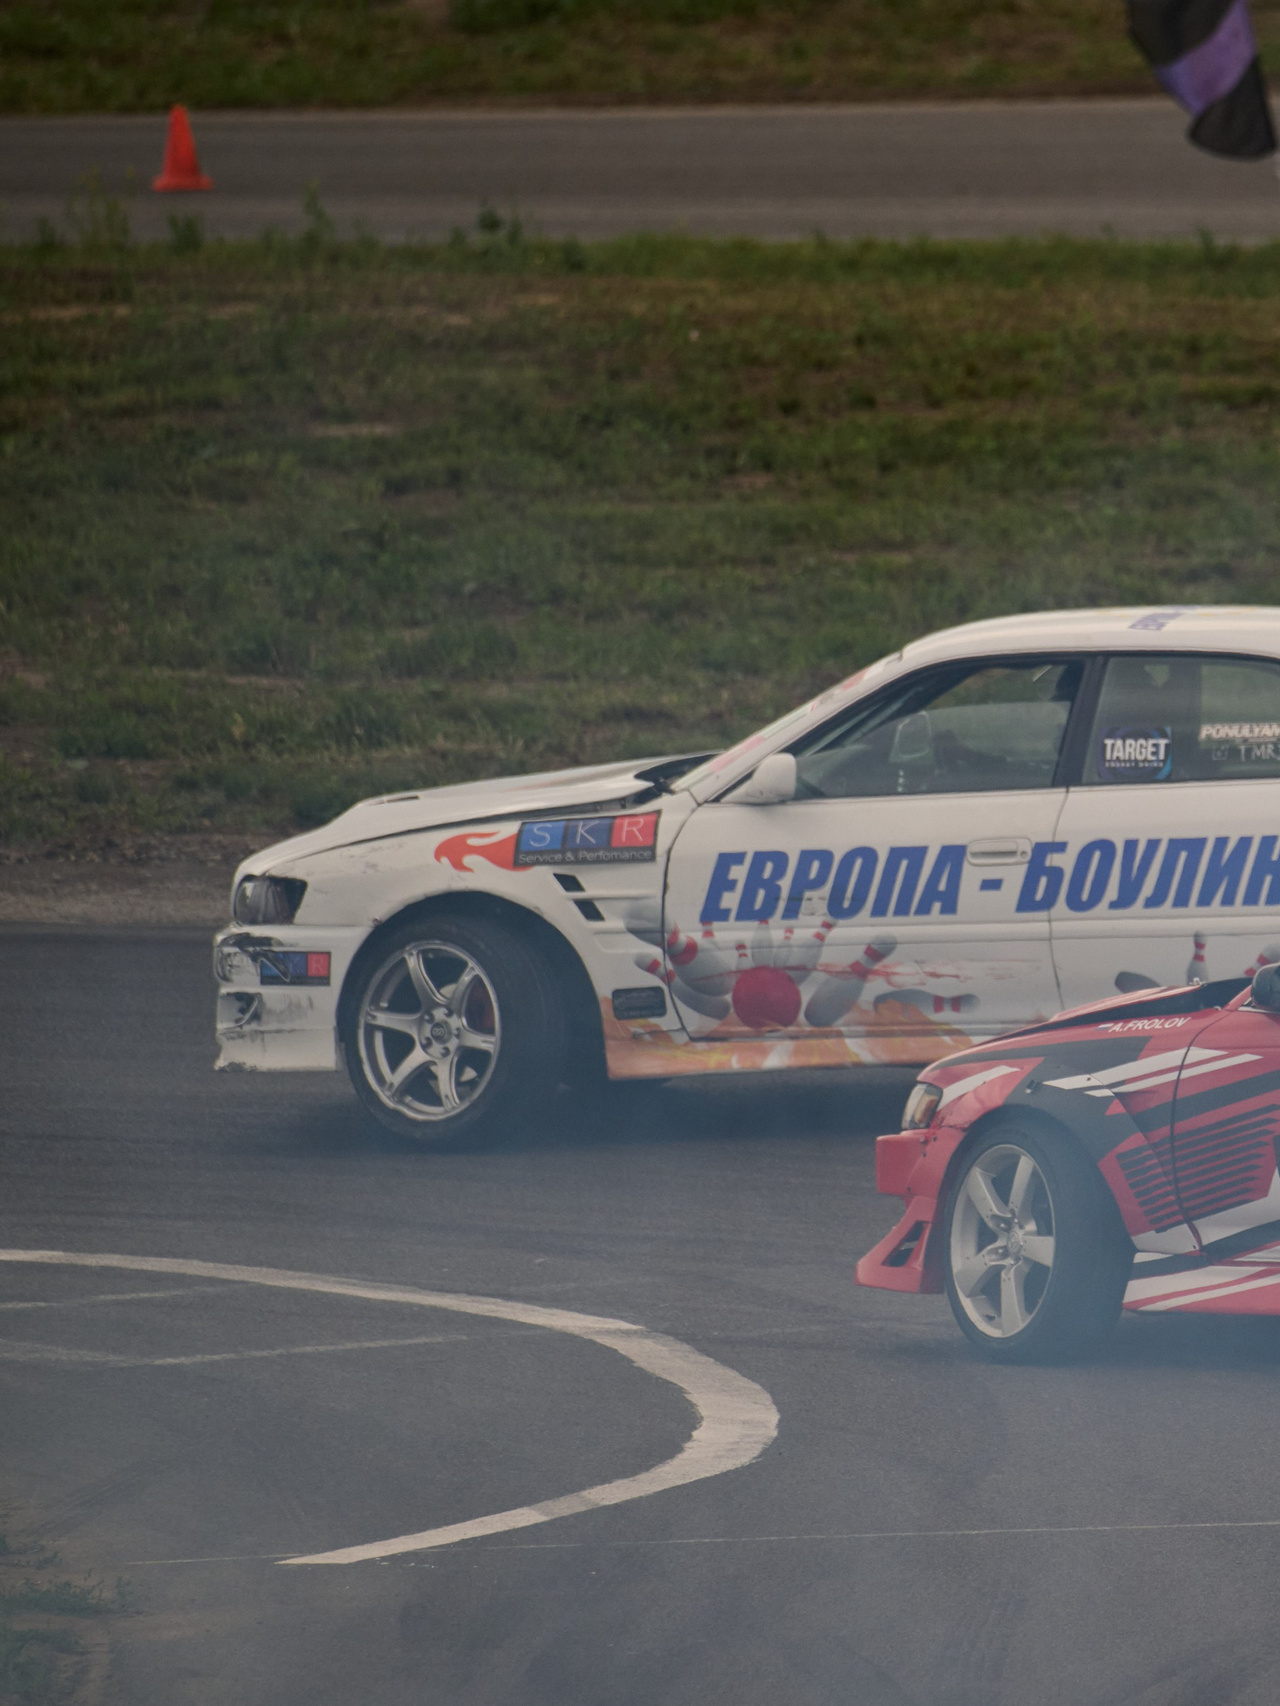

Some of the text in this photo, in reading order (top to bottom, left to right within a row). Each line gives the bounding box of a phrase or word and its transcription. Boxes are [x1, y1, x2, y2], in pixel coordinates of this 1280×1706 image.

[1104, 738, 1169, 761] TARGET
[529, 818, 644, 847] SKR
[518, 853, 563, 864] Service
[565, 851, 575, 862] &
[699, 845, 968, 921] ЕВРОПА
[1108, 1017, 1191, 1033] A.FROLOV
